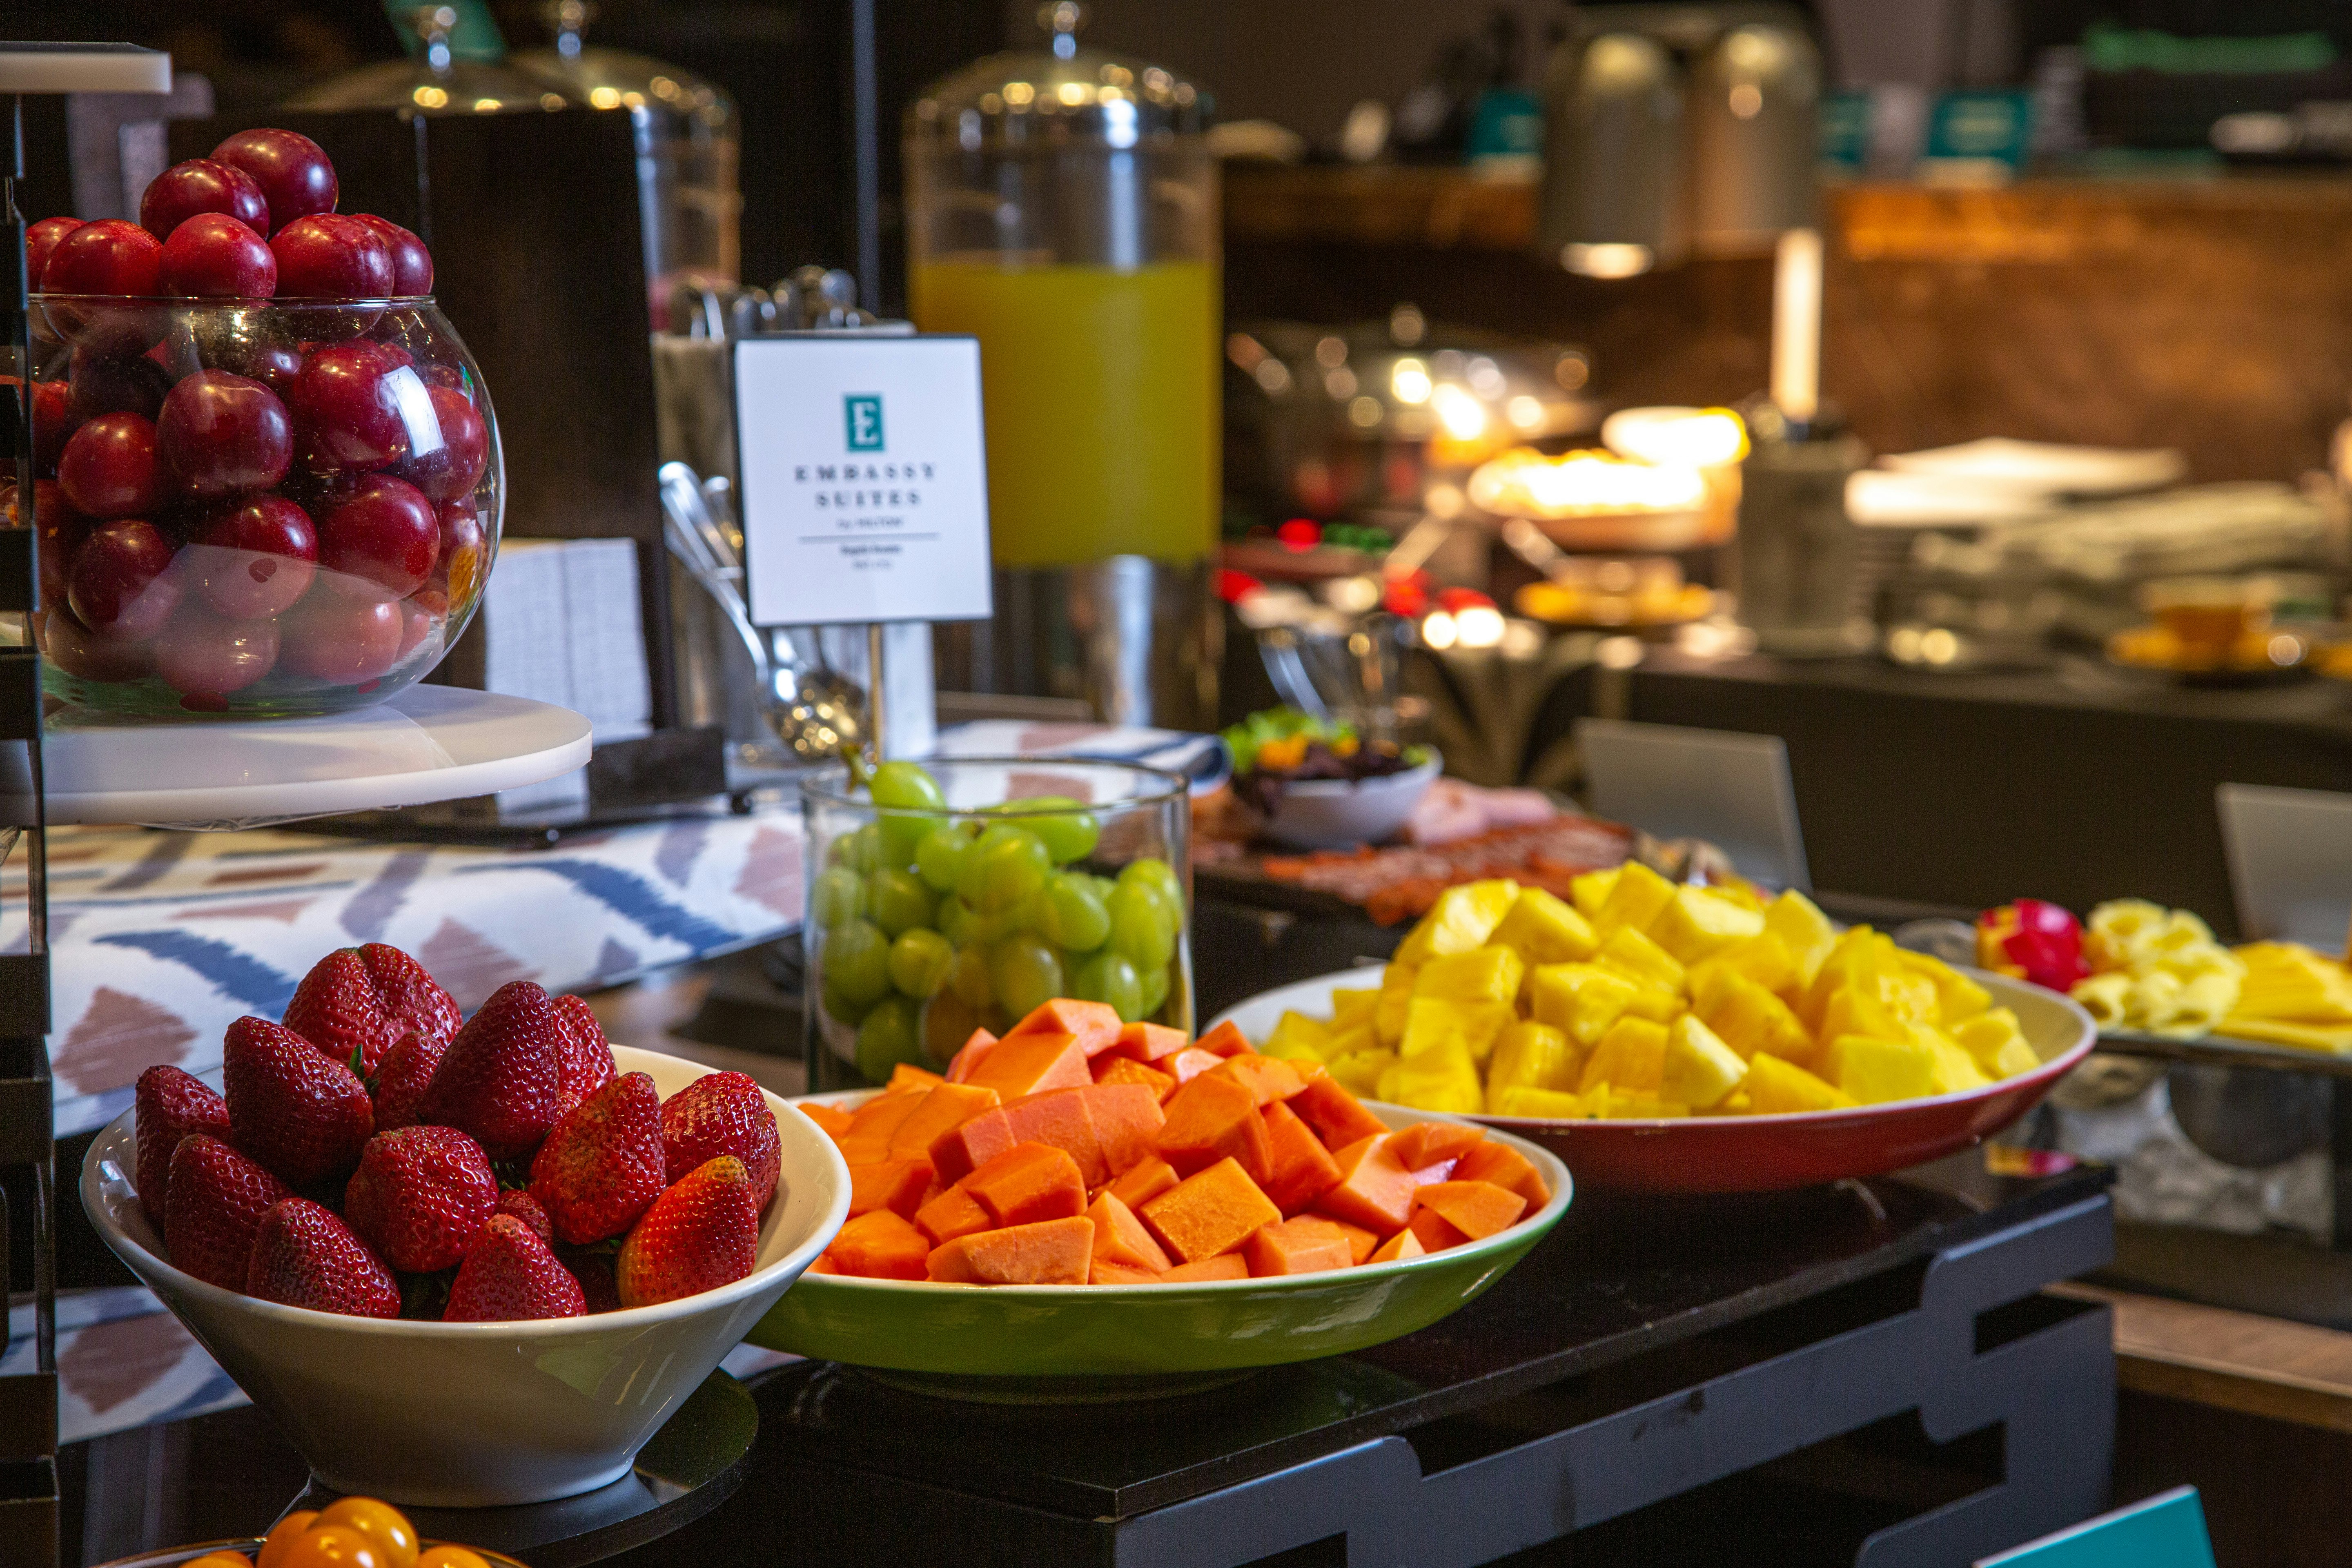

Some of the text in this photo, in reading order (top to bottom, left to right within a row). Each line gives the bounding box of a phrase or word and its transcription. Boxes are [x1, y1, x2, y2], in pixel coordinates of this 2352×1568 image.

[852, 399, 880, 446] E
[795, 463, 935, 483] EMBASSY
[816, 490, 920, 509] SUITES
